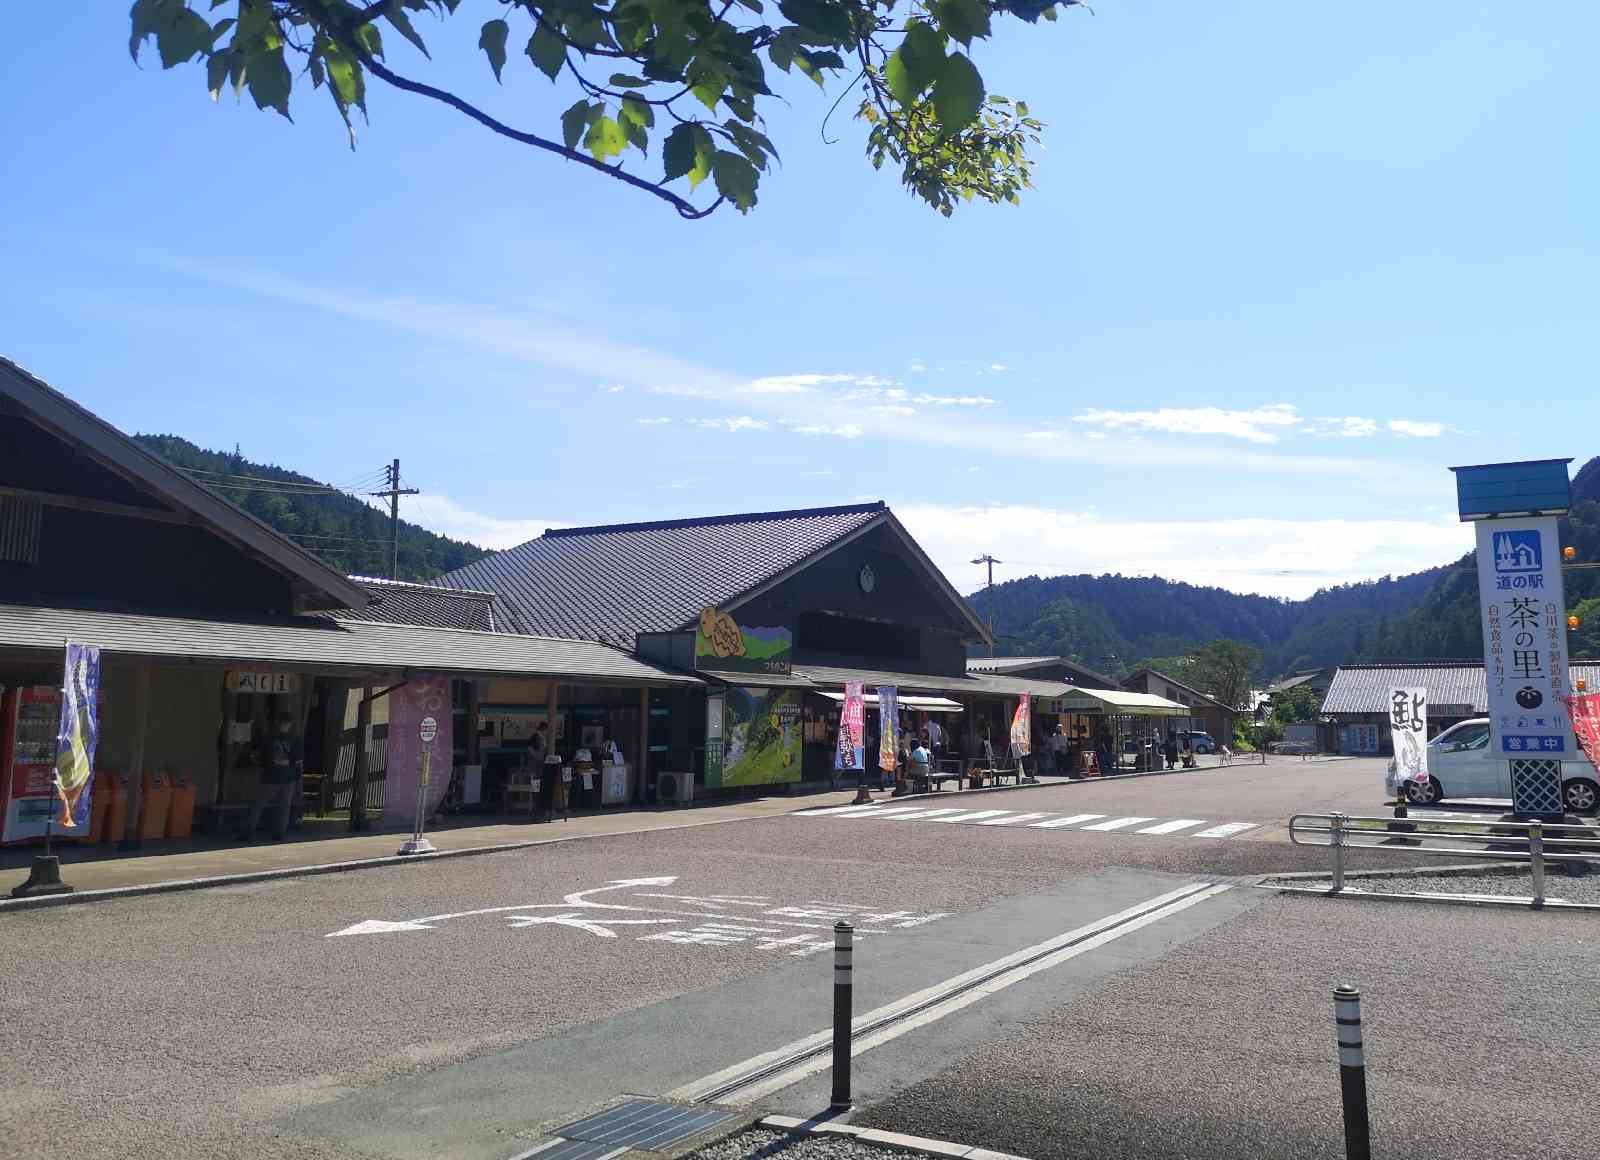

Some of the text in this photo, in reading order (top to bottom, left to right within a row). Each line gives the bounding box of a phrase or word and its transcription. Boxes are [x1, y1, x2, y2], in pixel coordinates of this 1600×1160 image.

[1496, 574, 1544, 590] 道の駅
[1504, 597, 1545, 679] 茶の里
[1392, 690, 1425, 732] 鮎
[1508, 737, 1558, 750] 営業中
